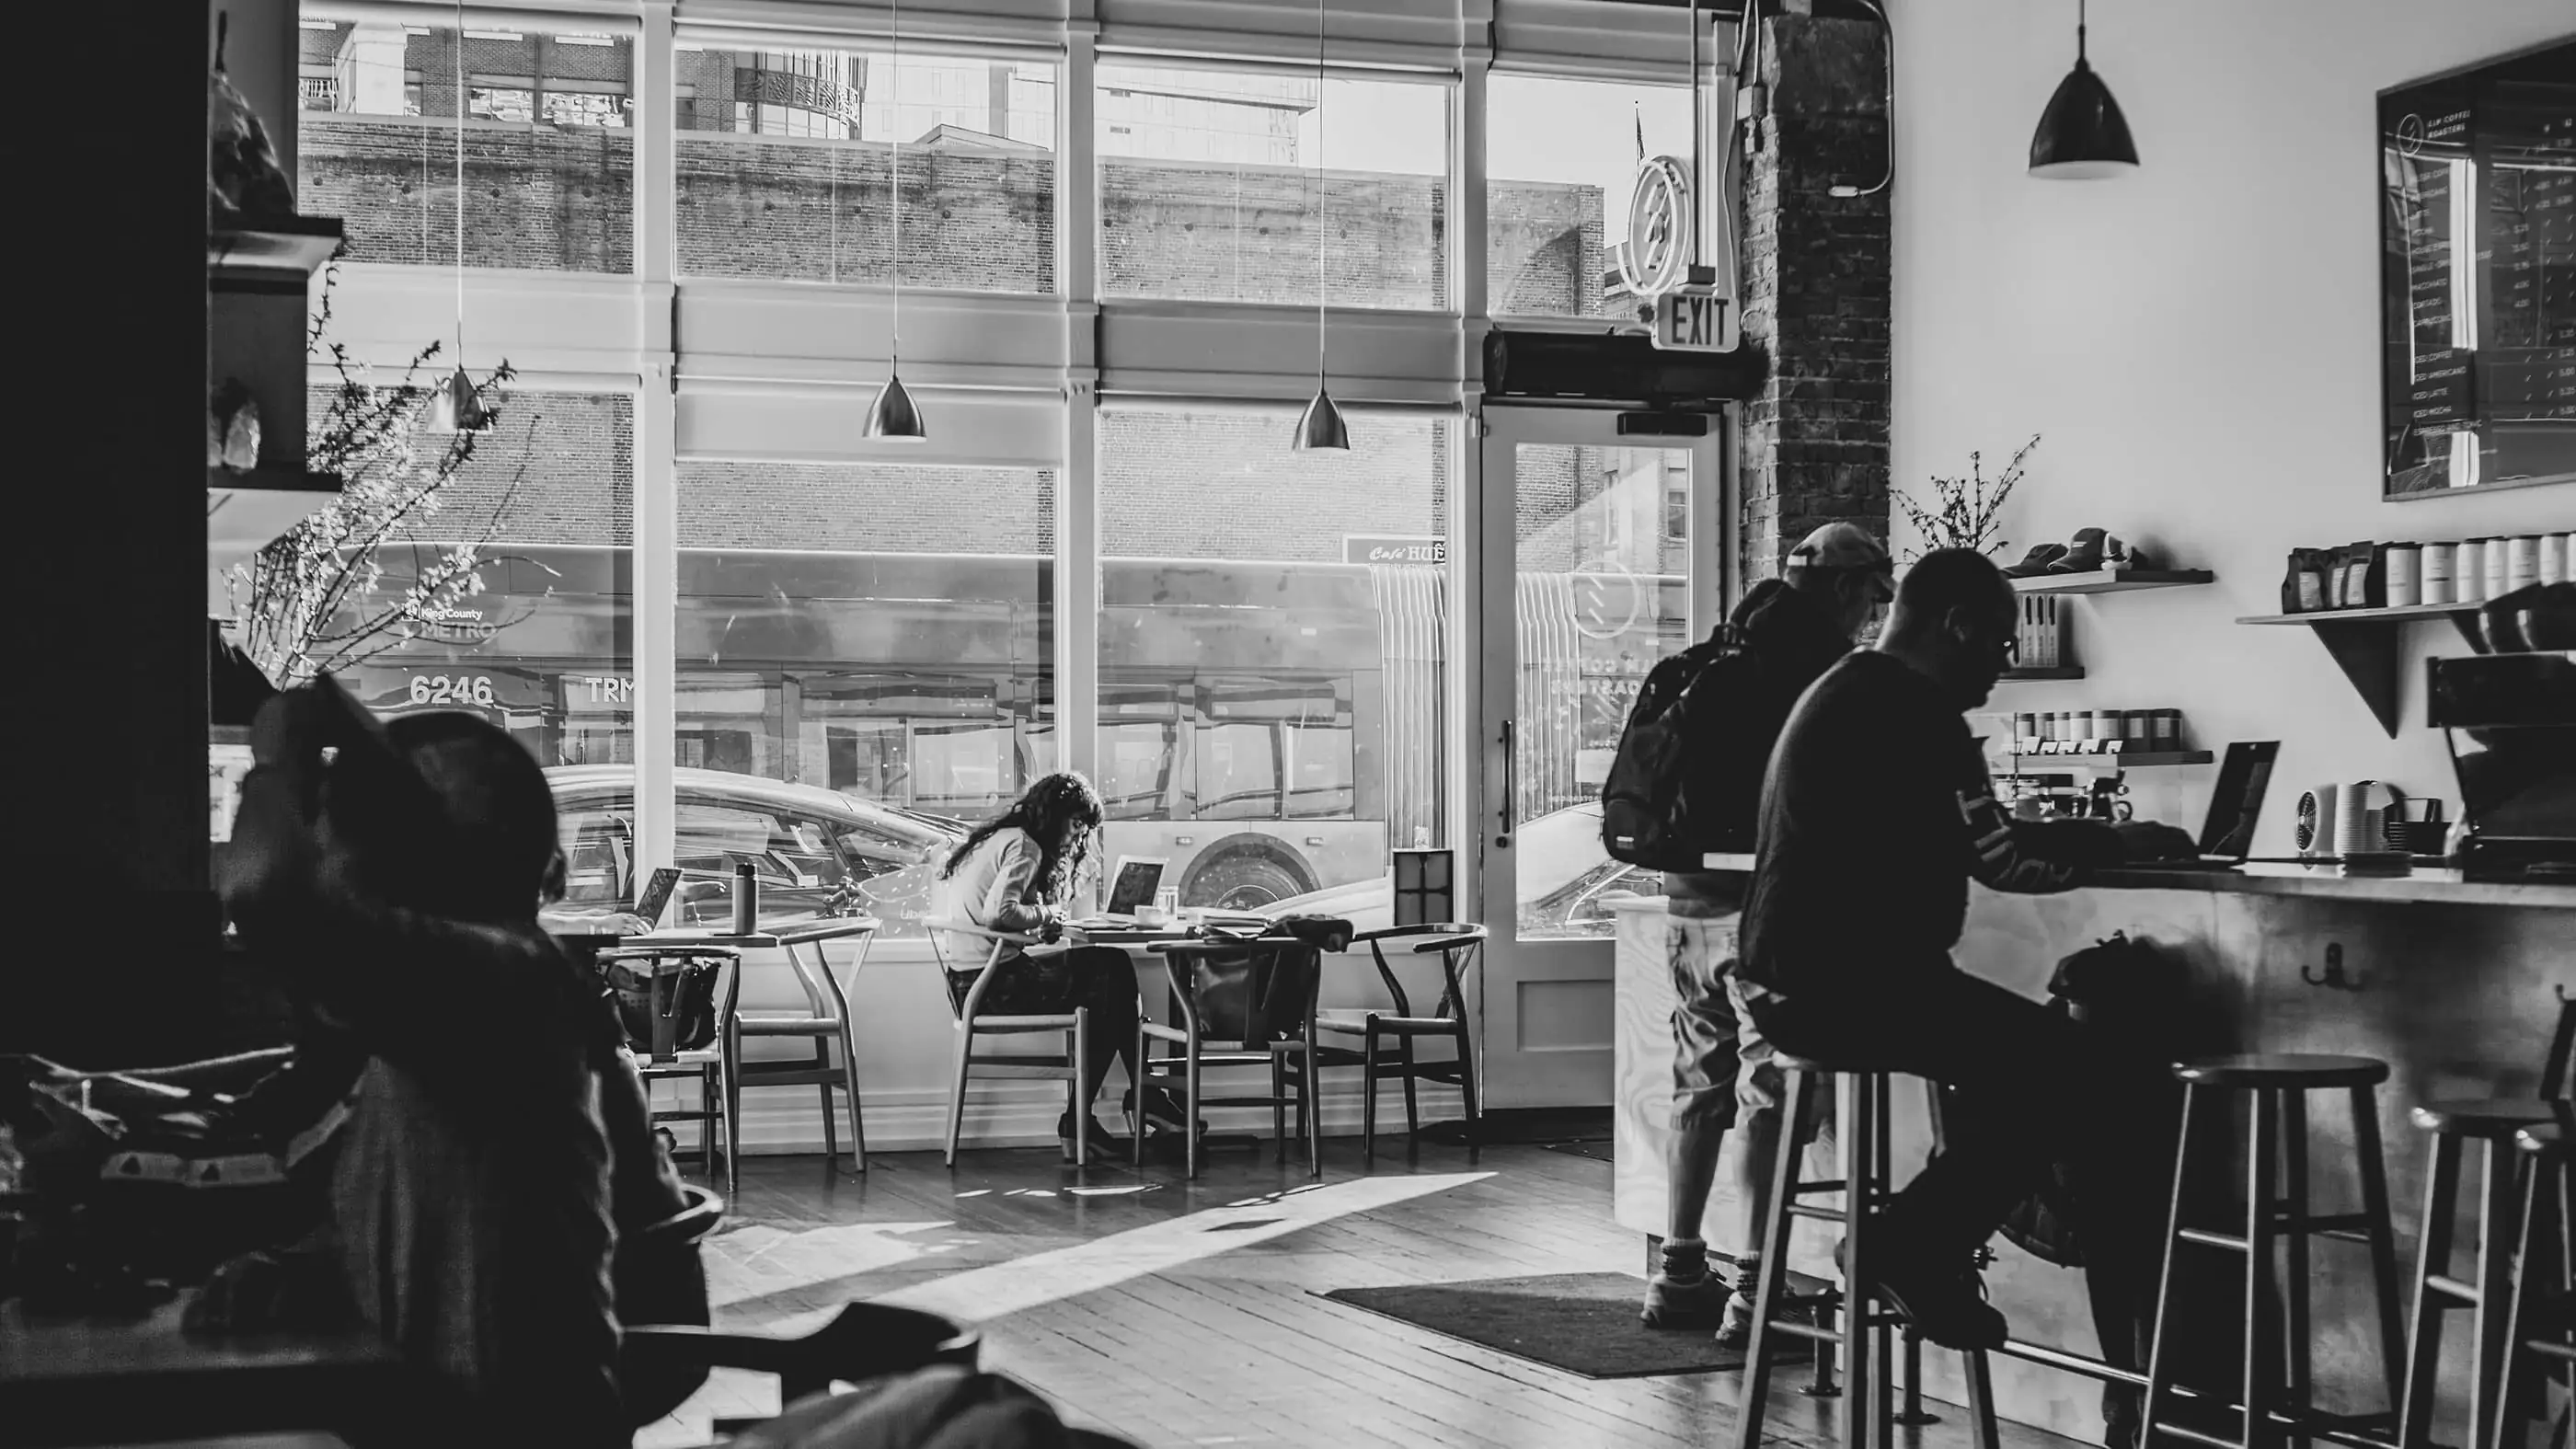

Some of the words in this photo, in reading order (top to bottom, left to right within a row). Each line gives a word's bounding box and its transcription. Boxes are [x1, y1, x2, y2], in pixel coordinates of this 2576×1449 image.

[1672, 295, 1730, 347] EXIT
[421, 608, 445, 620] Kng
[446, 608, 483, 621] County
[420, 622, 497, 638] METRO
[410, 675, 494, 705] 6246
